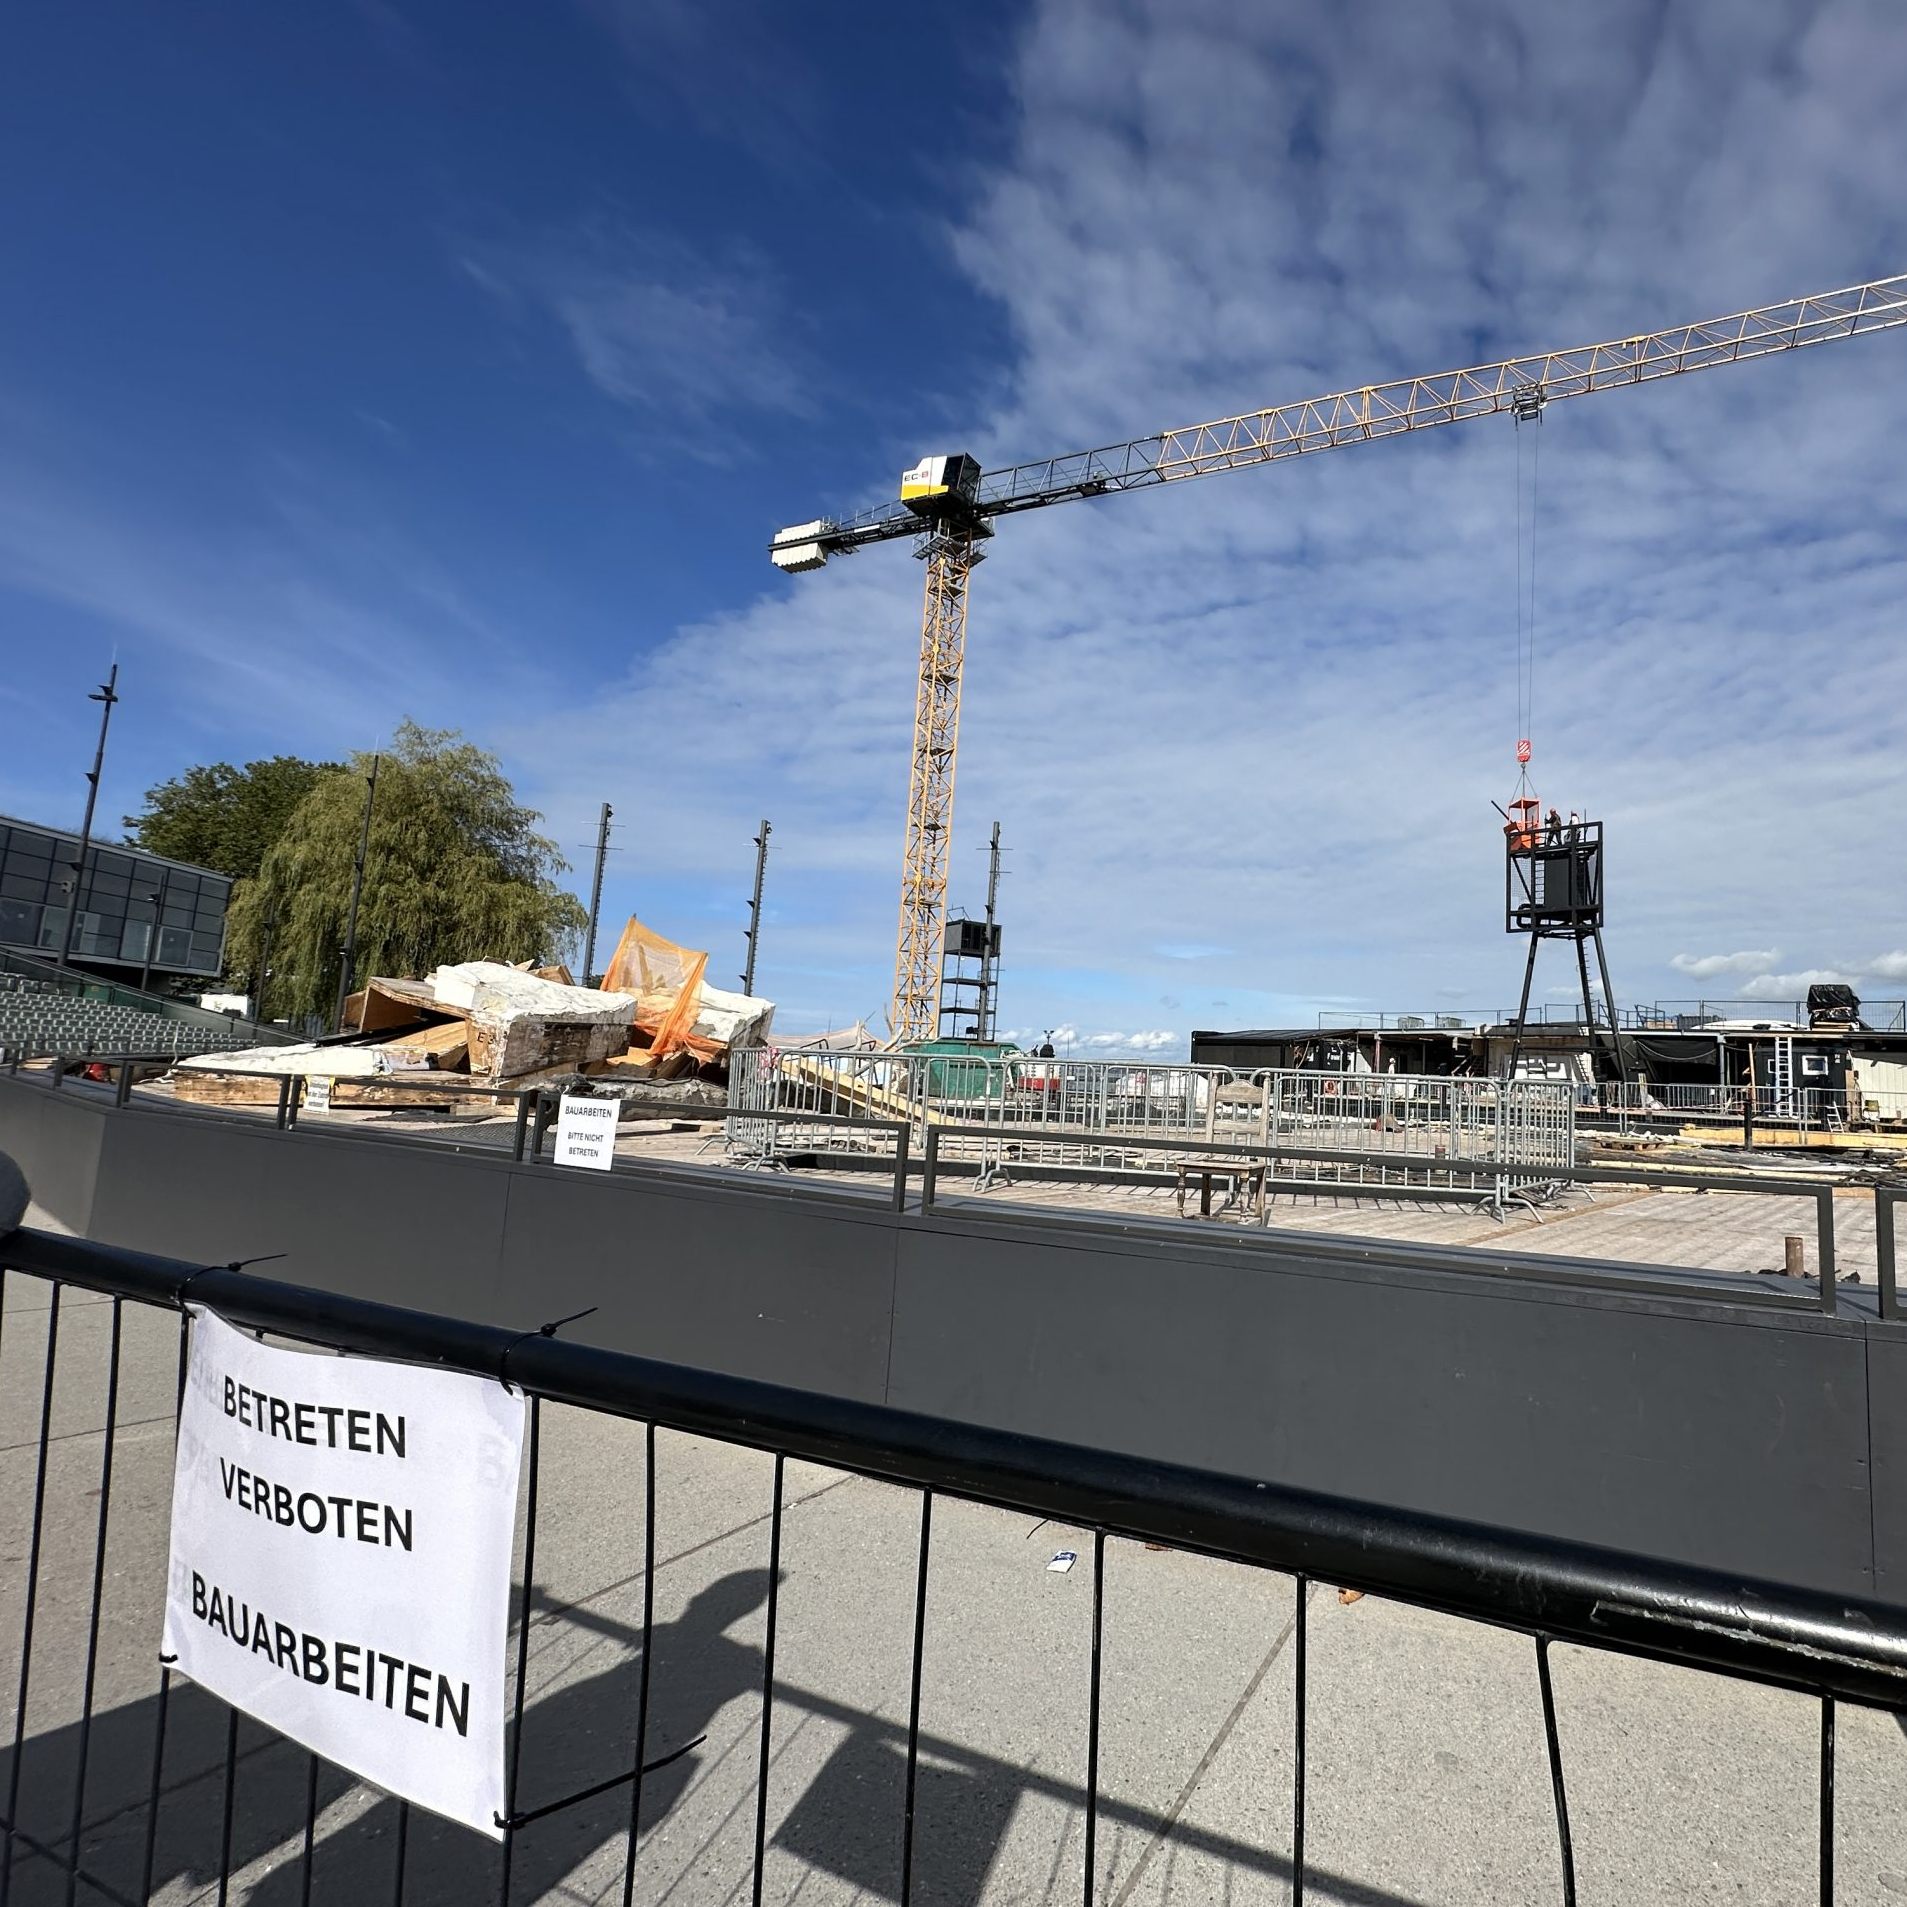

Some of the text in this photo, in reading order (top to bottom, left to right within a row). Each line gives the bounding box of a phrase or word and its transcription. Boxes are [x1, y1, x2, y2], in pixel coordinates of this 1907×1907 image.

[565, 1105, 612, 1118] BAUARBEITEN
[567, 1131, 604, 1143] BITTE NICHT
[568, 1146, 599, 1157] BETRETEN
[223, 1374, 406, 1459] BETRETEN
[220, 1456, 413, 1552] VERBOTEN
[192, 1570, 470, 1738] BAUARBEITEN
